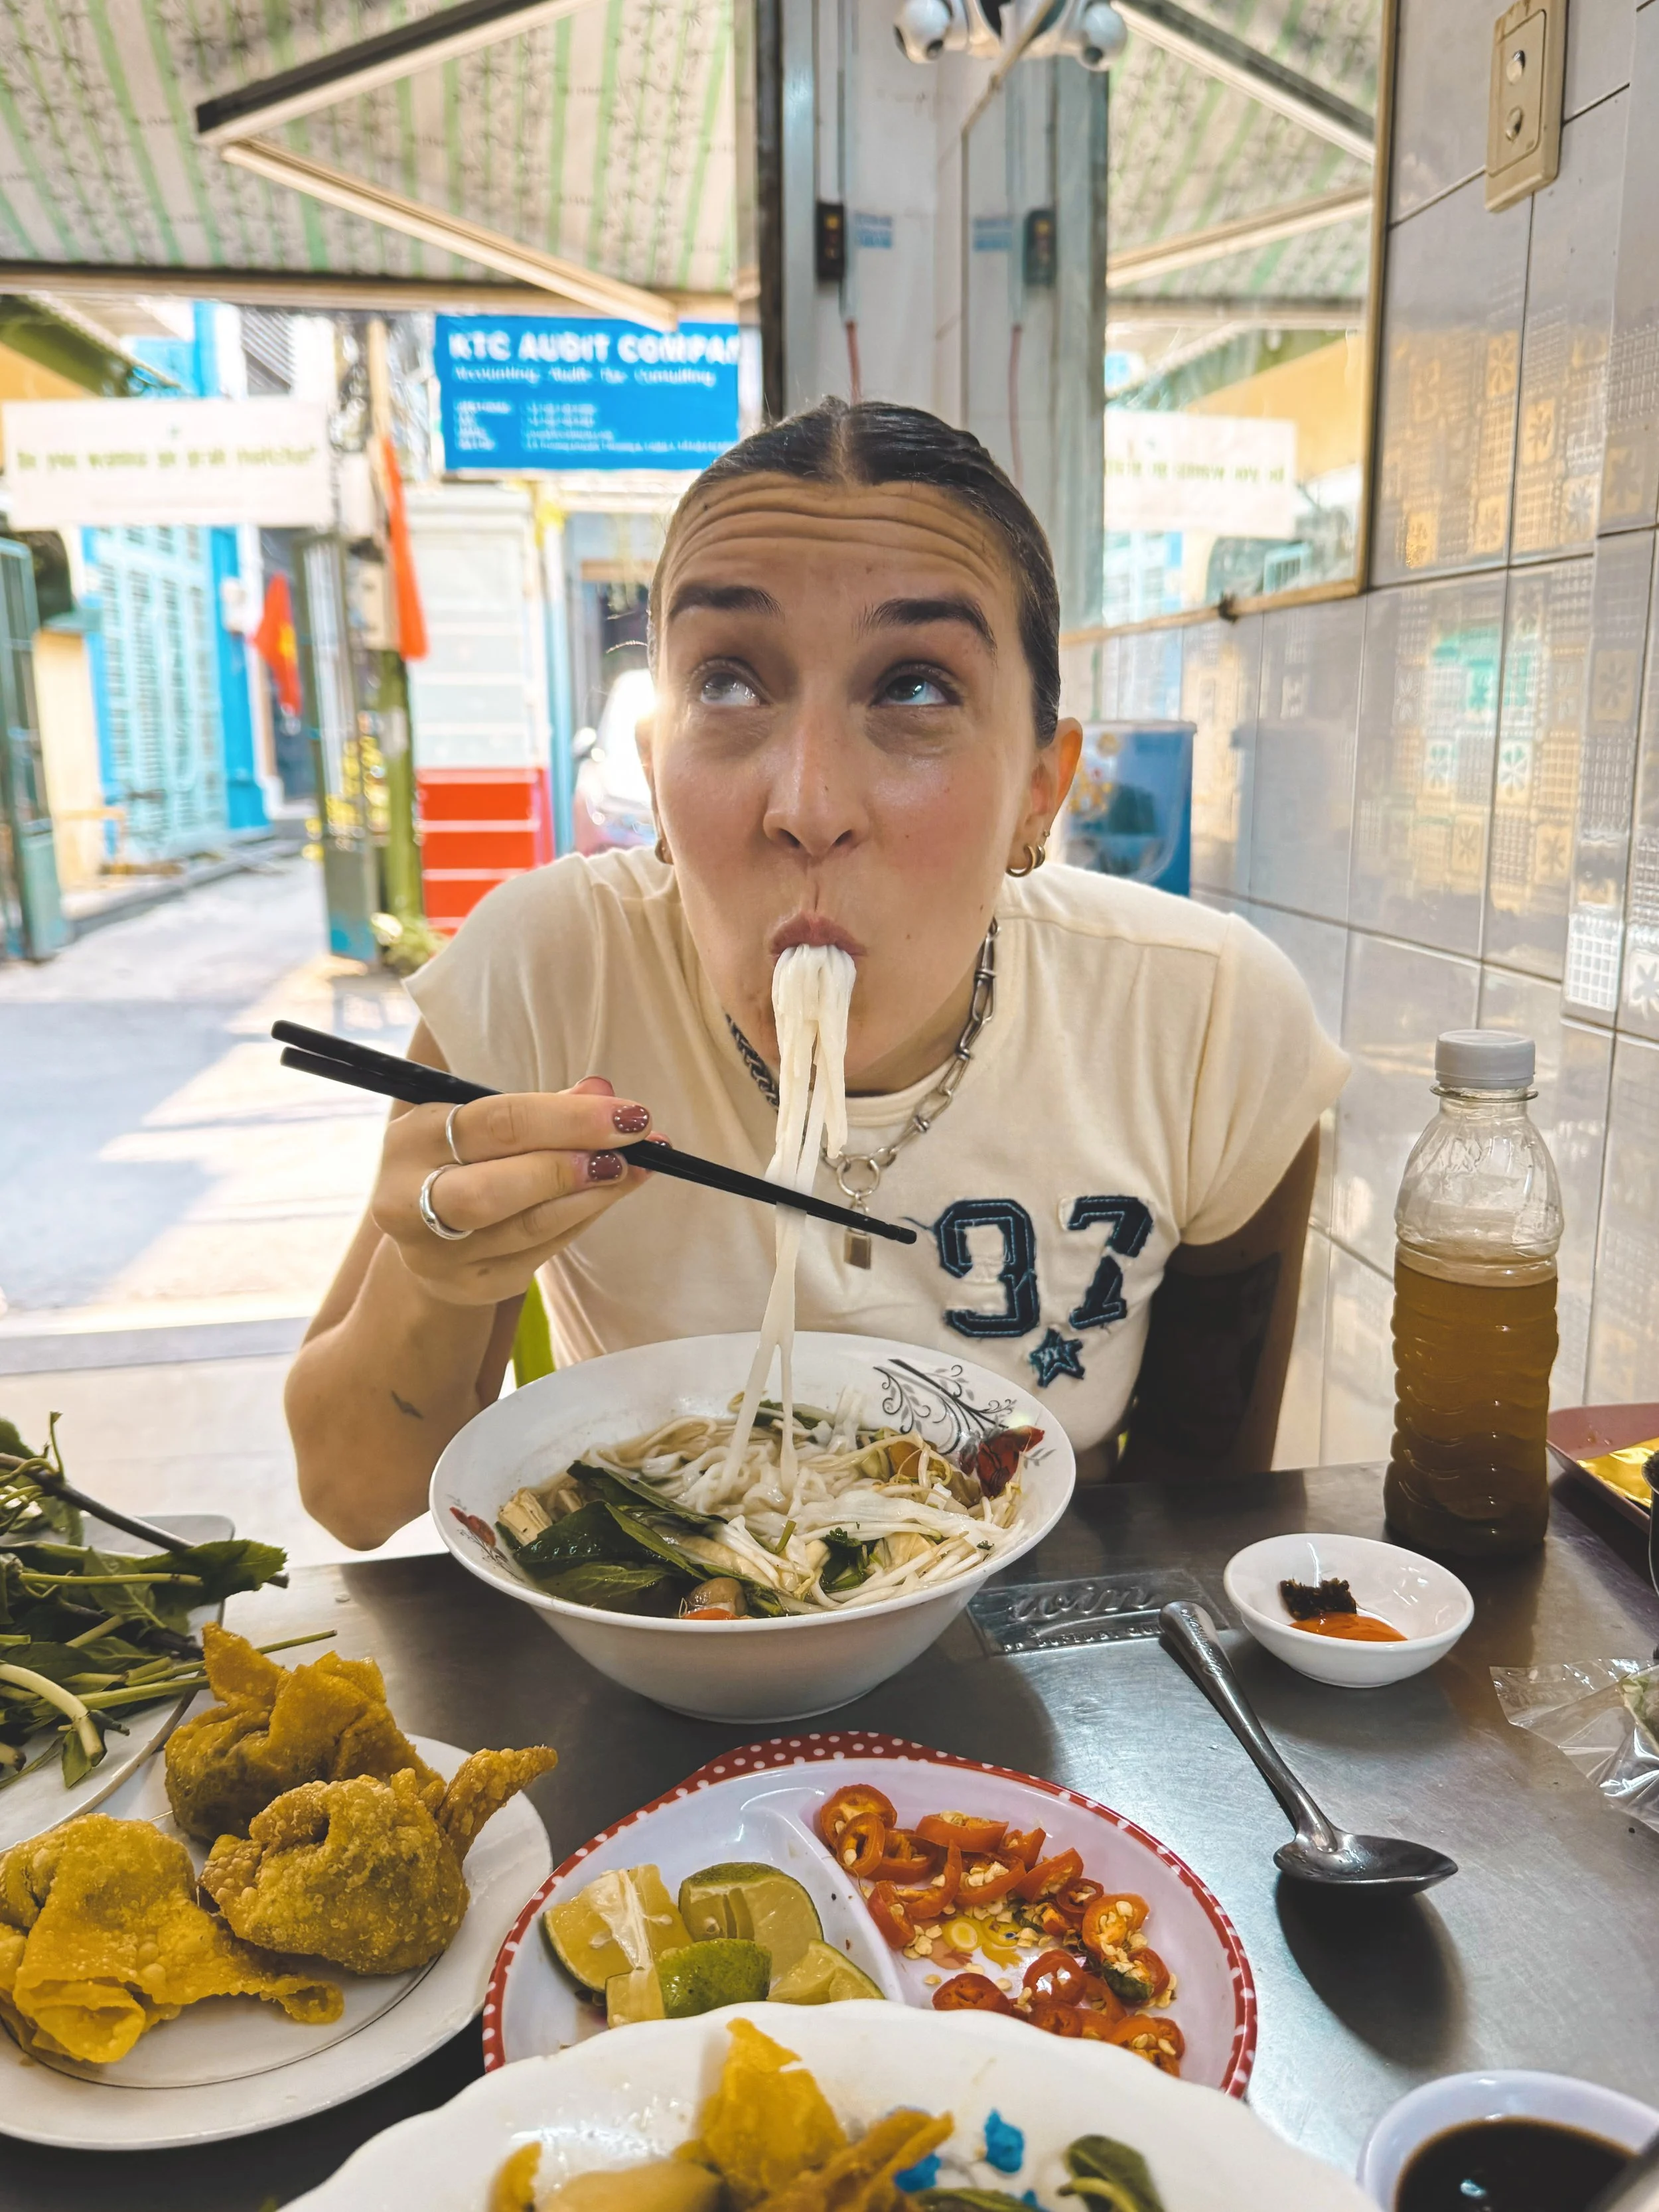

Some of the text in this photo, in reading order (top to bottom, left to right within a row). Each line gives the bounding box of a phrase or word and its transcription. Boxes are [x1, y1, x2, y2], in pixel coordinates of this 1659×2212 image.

[449, 332, 511, 360] KTC
[518, 333, 610, 362] AUDIT
[932, 1196, 1153, 1338] 97
